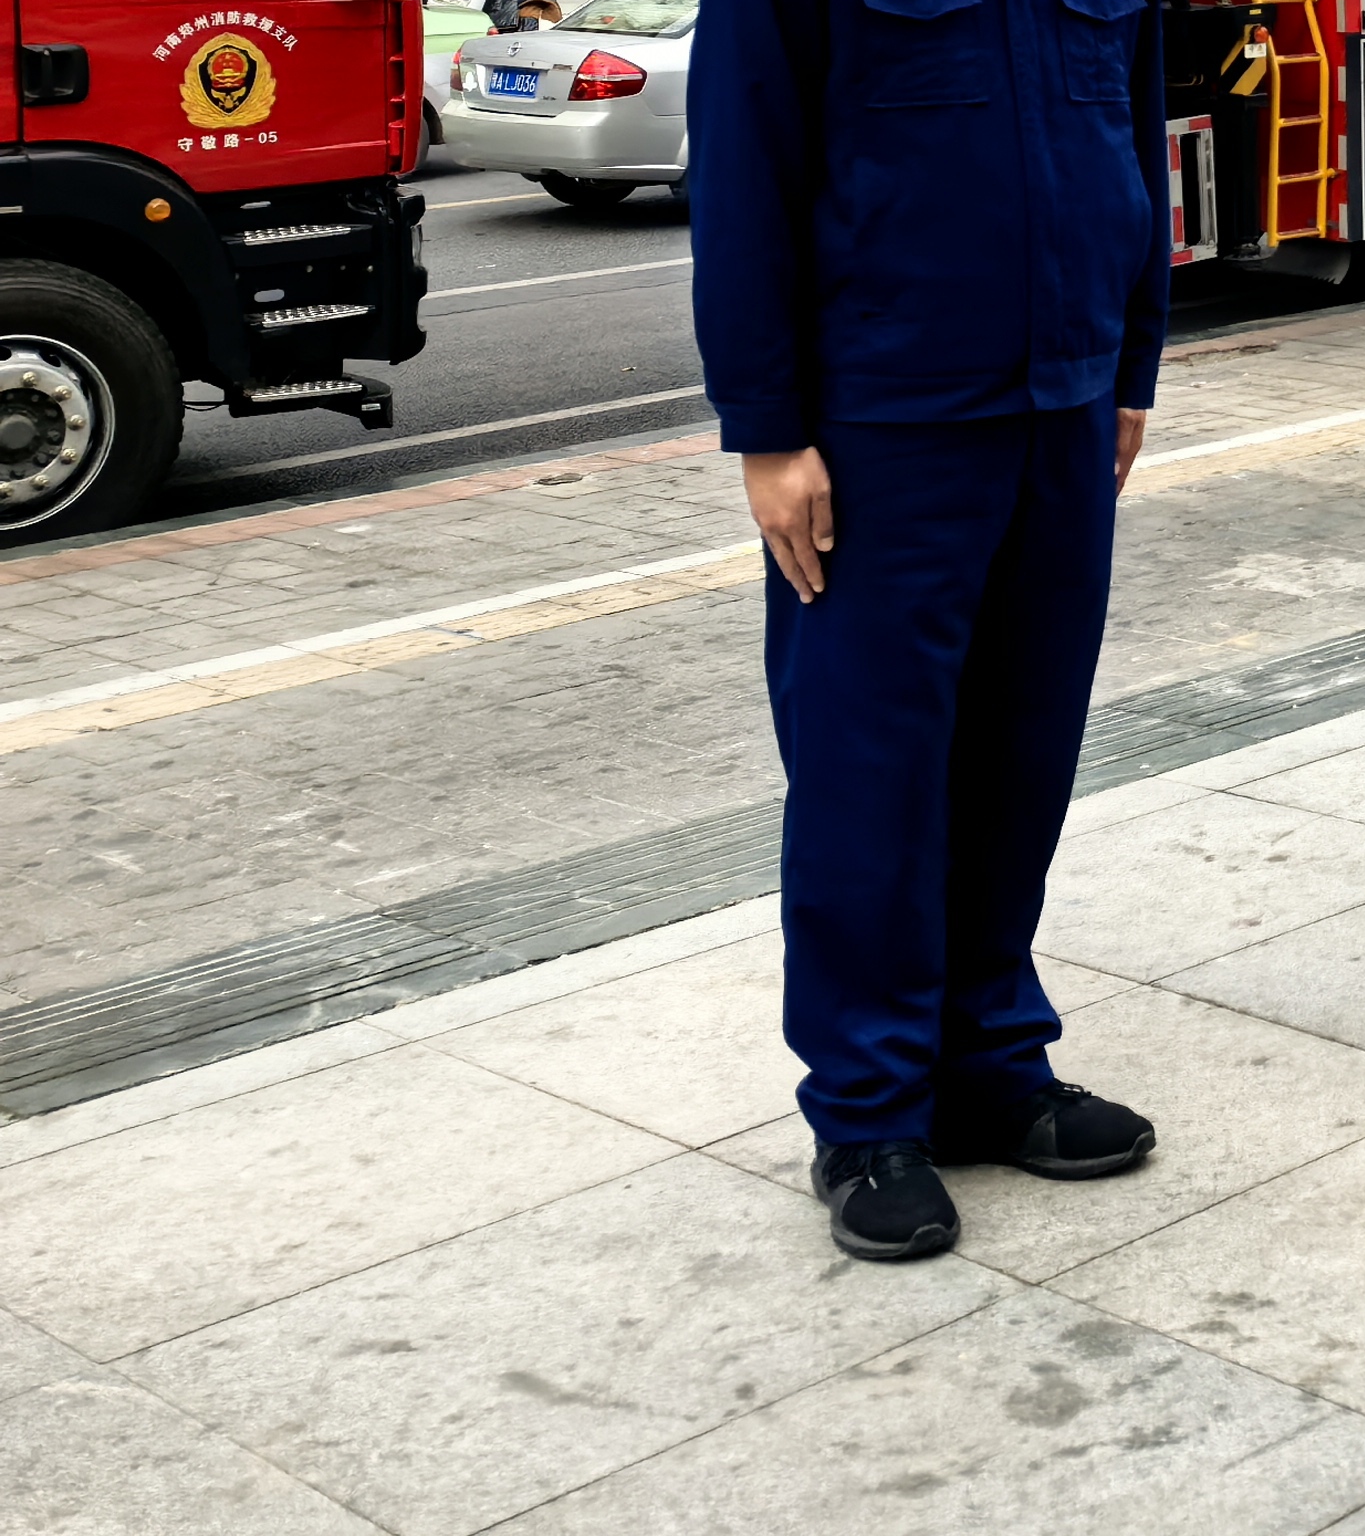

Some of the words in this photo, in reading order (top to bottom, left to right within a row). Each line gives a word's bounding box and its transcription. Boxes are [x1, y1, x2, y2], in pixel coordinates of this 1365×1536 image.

[152, 11, 298, 61] 河南郑州消防救援支队
